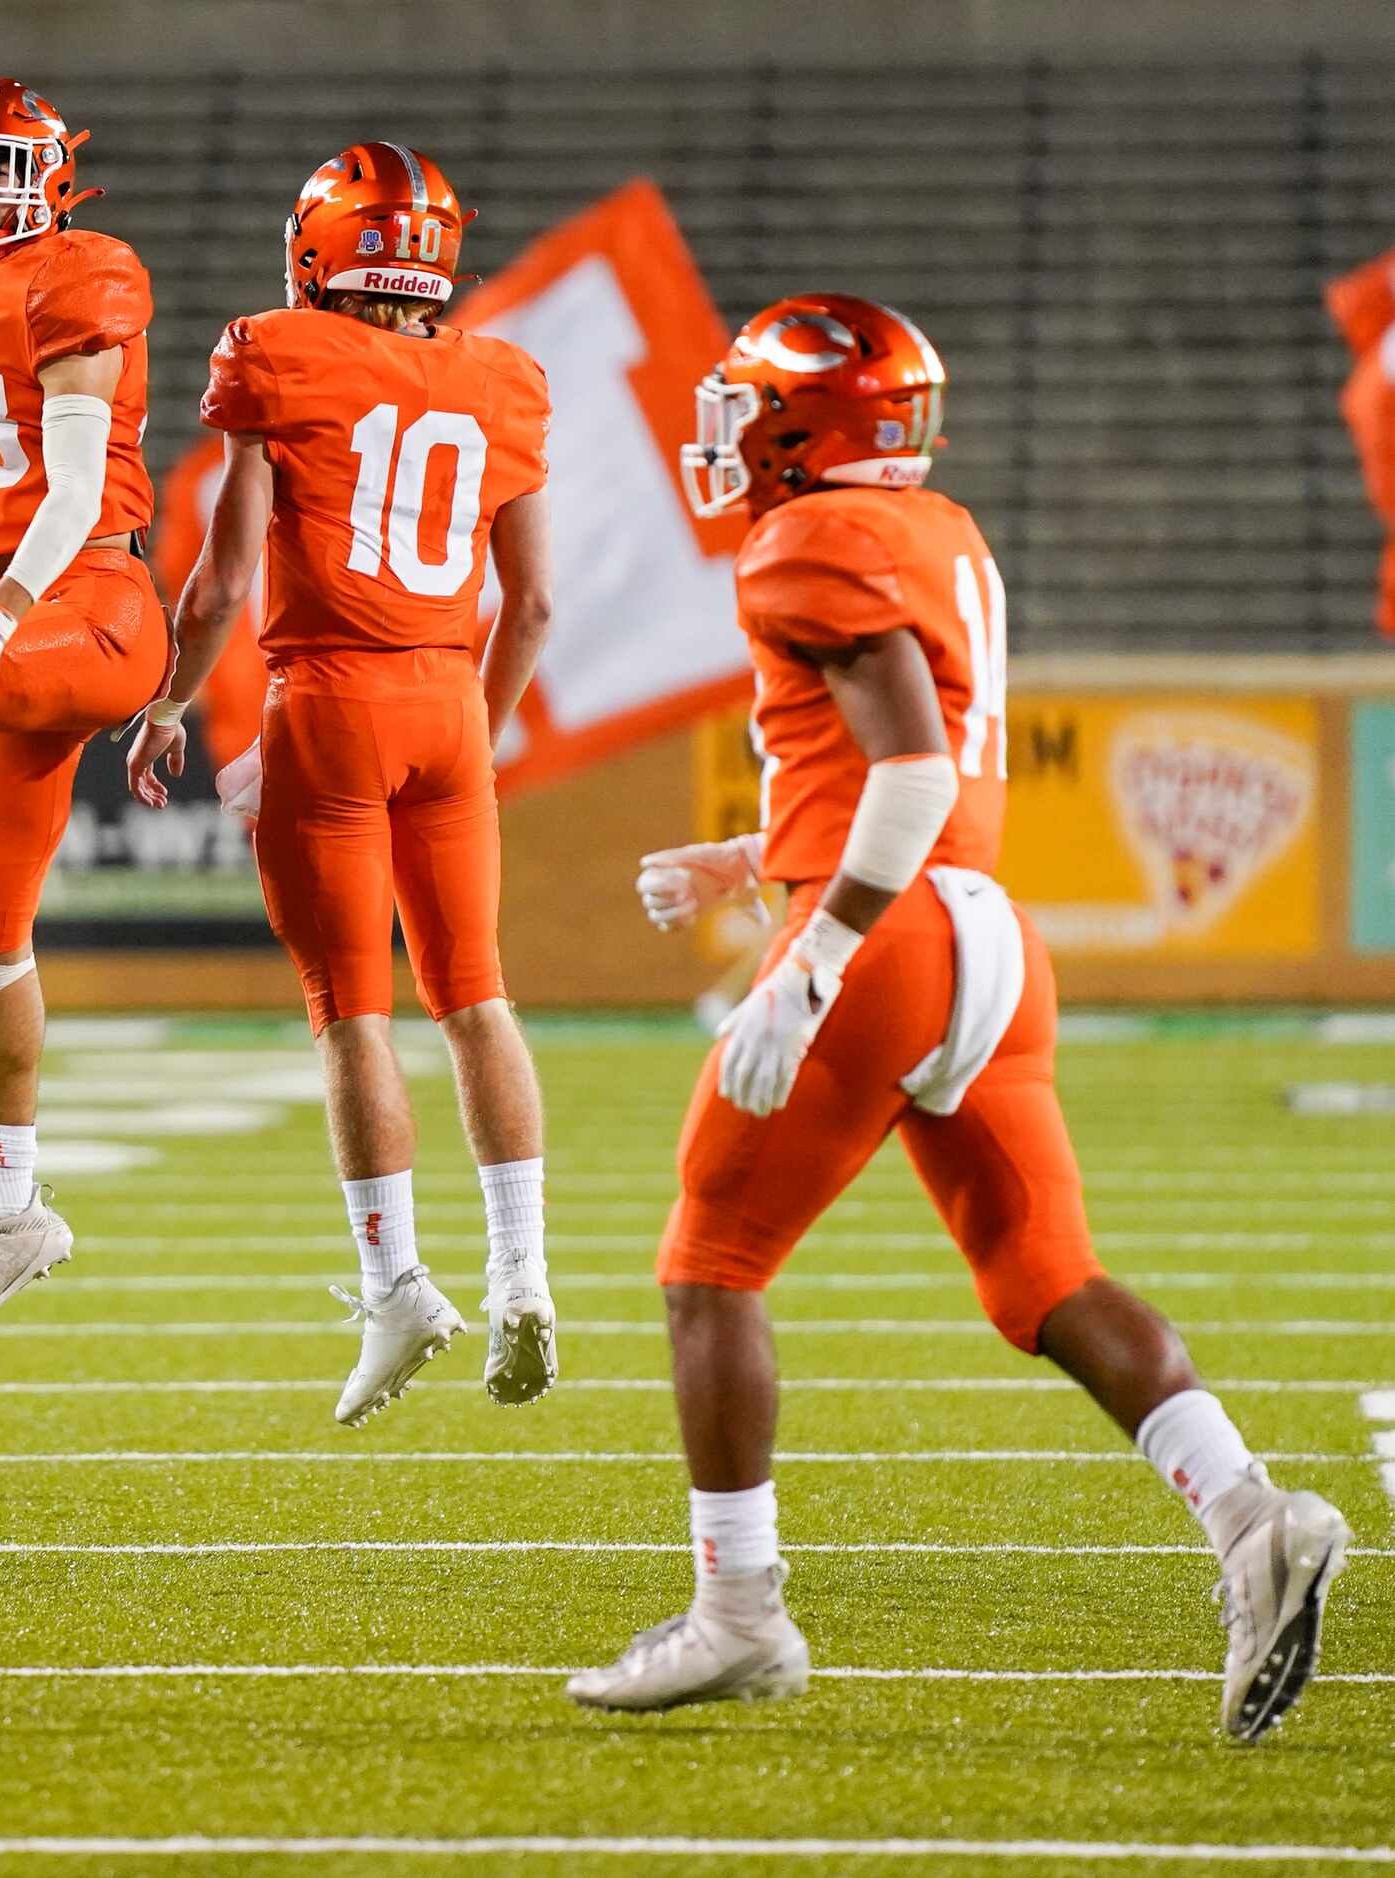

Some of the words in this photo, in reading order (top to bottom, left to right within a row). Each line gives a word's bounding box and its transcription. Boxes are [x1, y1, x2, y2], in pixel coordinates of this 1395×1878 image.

[394, 213, 441, 263] 10
[363, 271, 442, 296] Riddell
[346, 403, 489, 597] 10
